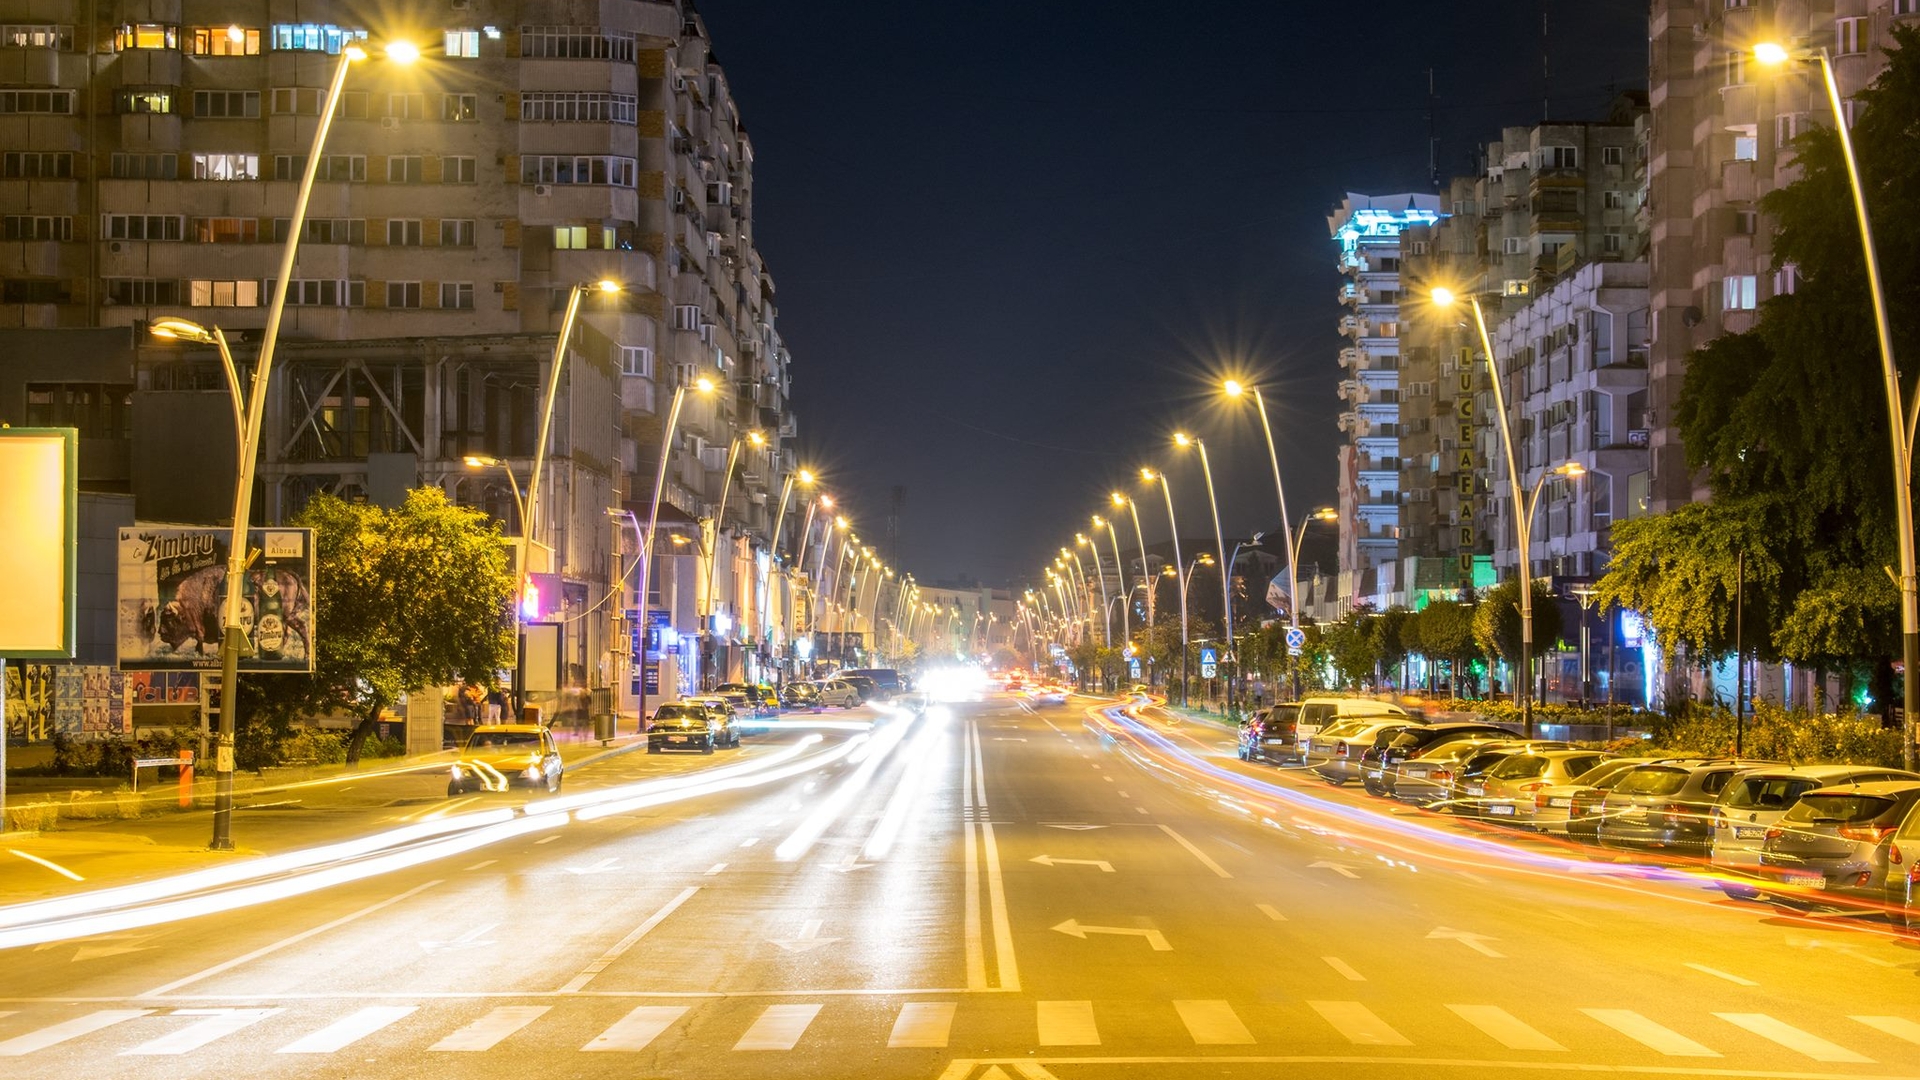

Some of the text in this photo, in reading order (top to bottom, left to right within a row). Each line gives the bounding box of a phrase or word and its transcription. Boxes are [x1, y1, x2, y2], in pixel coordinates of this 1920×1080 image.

[143, 532, 214, 563] Zimbru
[259, 630, 282, 642] Zimbru
[138, 686, 199, 704] CLUB
